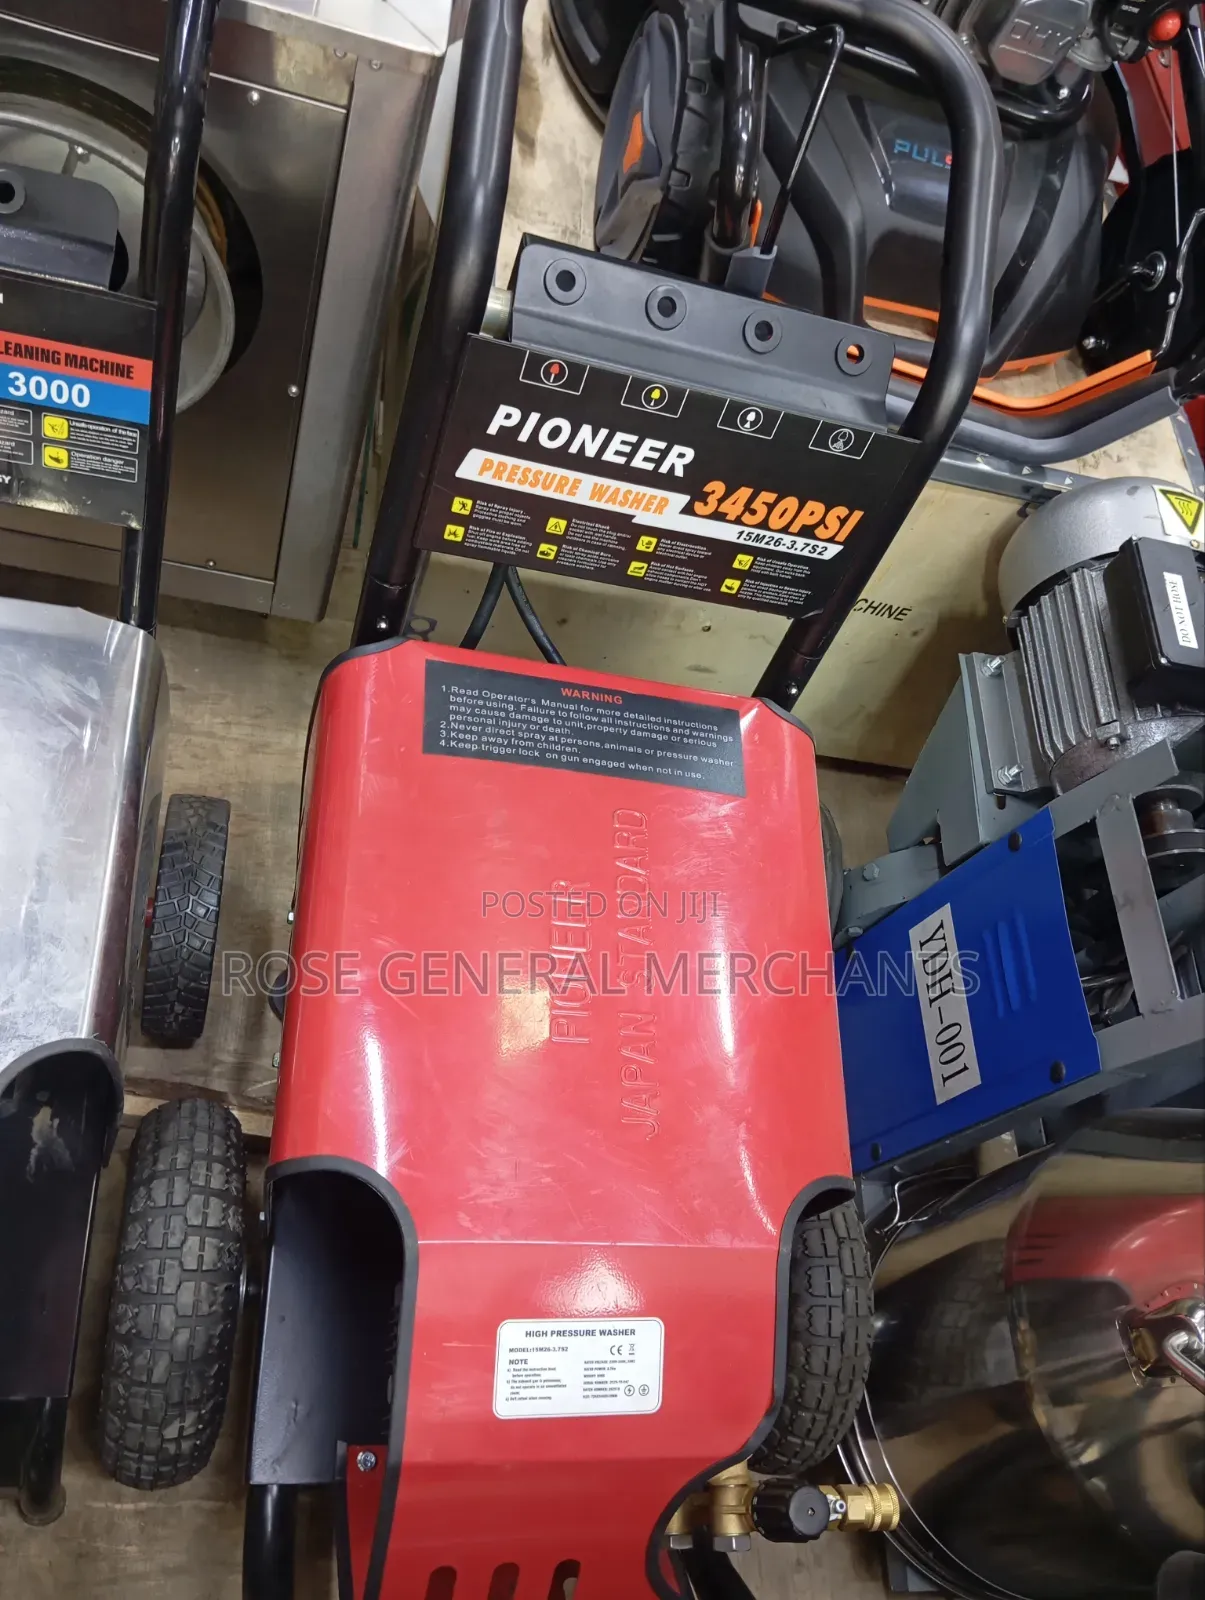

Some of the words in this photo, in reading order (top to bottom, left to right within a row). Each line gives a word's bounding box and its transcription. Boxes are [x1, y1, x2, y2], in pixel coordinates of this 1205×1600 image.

[65, 355, 134, 380] MACHINE
[8, 371, 91, 408] 3000
[71, 451, 101, 461] Operation
[103, 456, 124, 465] danger
[486, 403, 695, 478] PIONEER
[478, 457, 582, 498] PRESSURE
[589, 482, 670, 516] WASHER
[693, 480, 864, 543] 3450PSI
[736, 529, 828, 557] 15M26-3.7S2
[482, 690, 536, 705] Operator's
[542, 699, 578, 711] Manual
[580, 704, 594, 712] for
[597, 709, 620, 717] more
[624, 711, 662, 723] detailed
[664, 717, 718, 732] instructions
[561, 687, 623, 705] WARNING
[450, 695, 484, 706] before
[486, 700, 516, 712] using.
[520, 704, 556, 716] Failure
[558, 710, 568, 718] to
[570, 712, 598, 722] follow
[601, 716, 612, 724] all
[614, 718, 670, 733] instructions
[672, 728, 690, 736] and
[692, 731, 734, 743] warnings
[450, 714, 496, 725] personal
[498, 718, 527, 730] injury
[530, 723, 540, 731] or
[542, 725, 574, 736] death.
[450, 704, 472, 714] may
[475, 708, 506, 718] cause
[509, 711, 550, 724] damage
[553, 718, 562, 726] to
[630, 729, 668, 741] damage
[683, 736, 717, 748] serious
[481, 734, 508, 746] away
[511, 738, 534, 748] from
[536, 741, 581, 754] children.
[481, 744, 516, 756] trigger
[518, 748, 540, 758] lock
[545, 752, 558, 760] on
[560, 754, 580, 763] gun
[582, 757, 626, 769] engaged
[628, 762, 654, 772] when
[656, 766, 672, 775] not
[674, 769, 683, 777] in
[684, 772, 706, 780] use.
[485, 725, 515, 736] direct
[518, 731, 546, 741] spray
[656, 750, 698, 762] pressure
[700, 756, 734, 767] washer
[918, 919, 970, 1088] YDH-001
[525, 1330, 548, 1338] HIGH
[550, 1329, 596, 1338] PRESSURE
[599, 1328, 636, 1336] WASHER
[508, 1358, 528, 1366] NOTE
